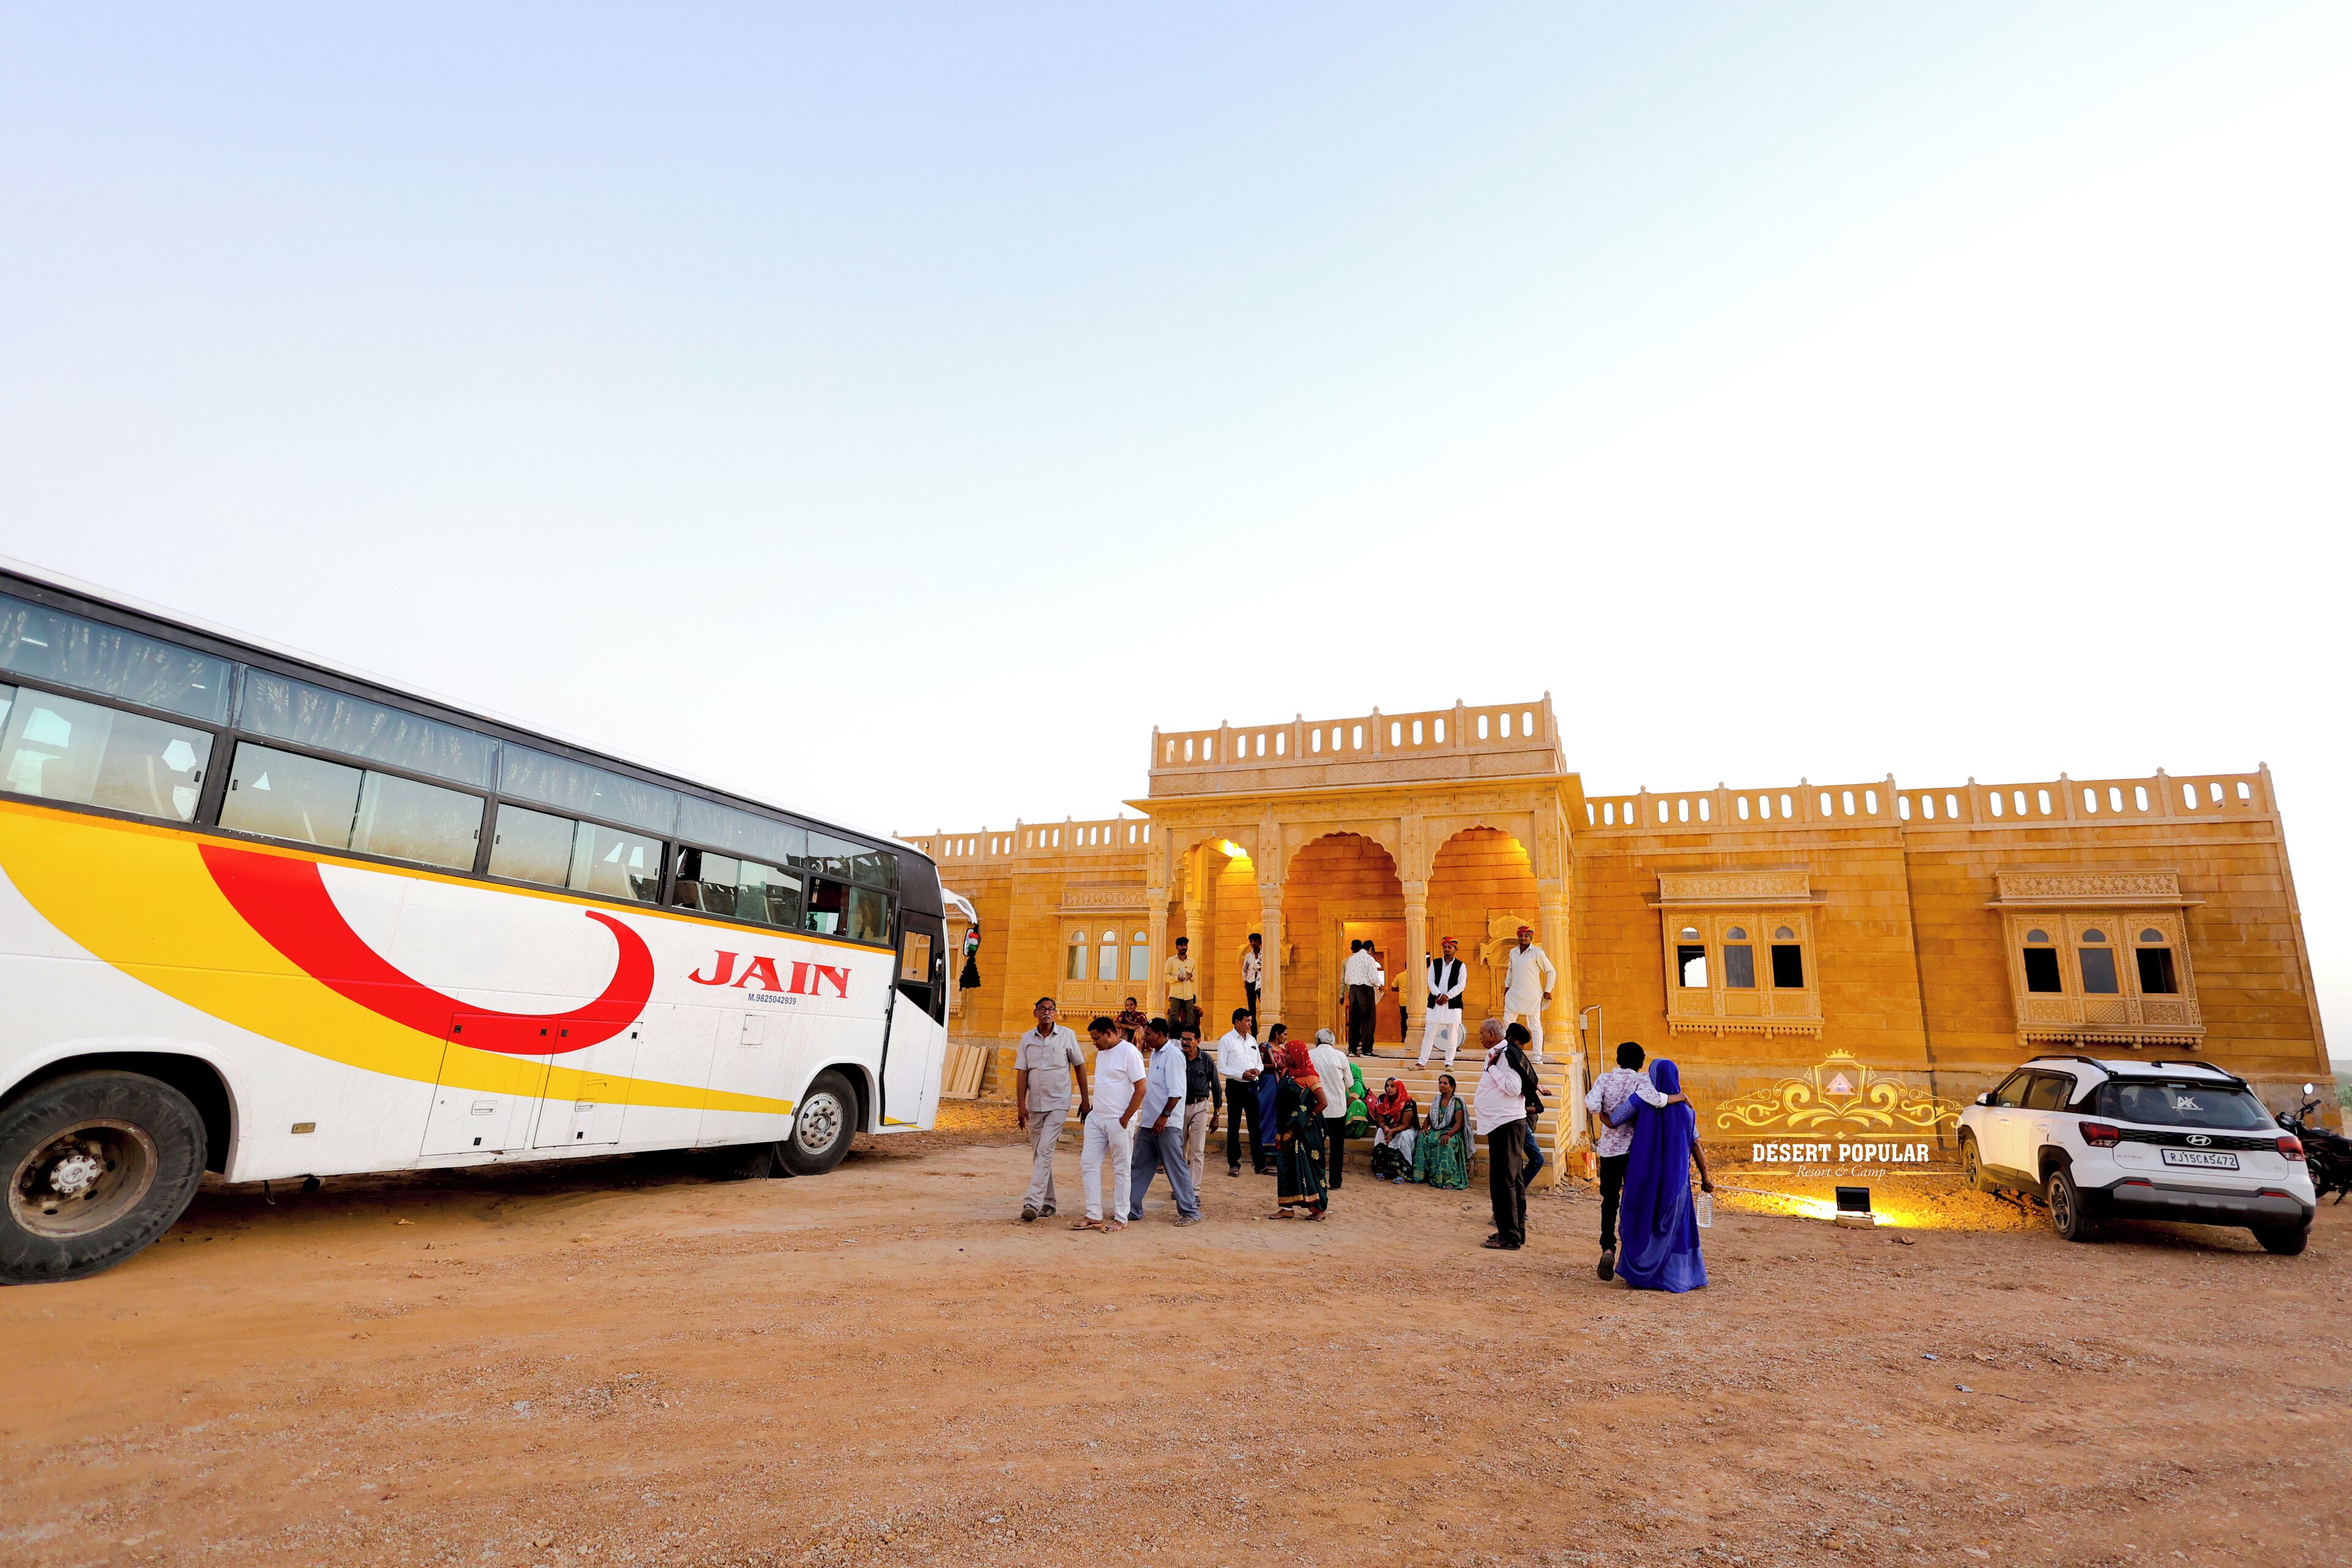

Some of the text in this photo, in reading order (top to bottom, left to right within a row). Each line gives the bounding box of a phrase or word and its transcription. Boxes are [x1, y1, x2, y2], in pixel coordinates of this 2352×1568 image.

[688, 950, 852, 998] JAIN
[748, 993, 796, 1005] M.9825042939
[2170, 1153, 2236, 1166] RJ15CA5472
